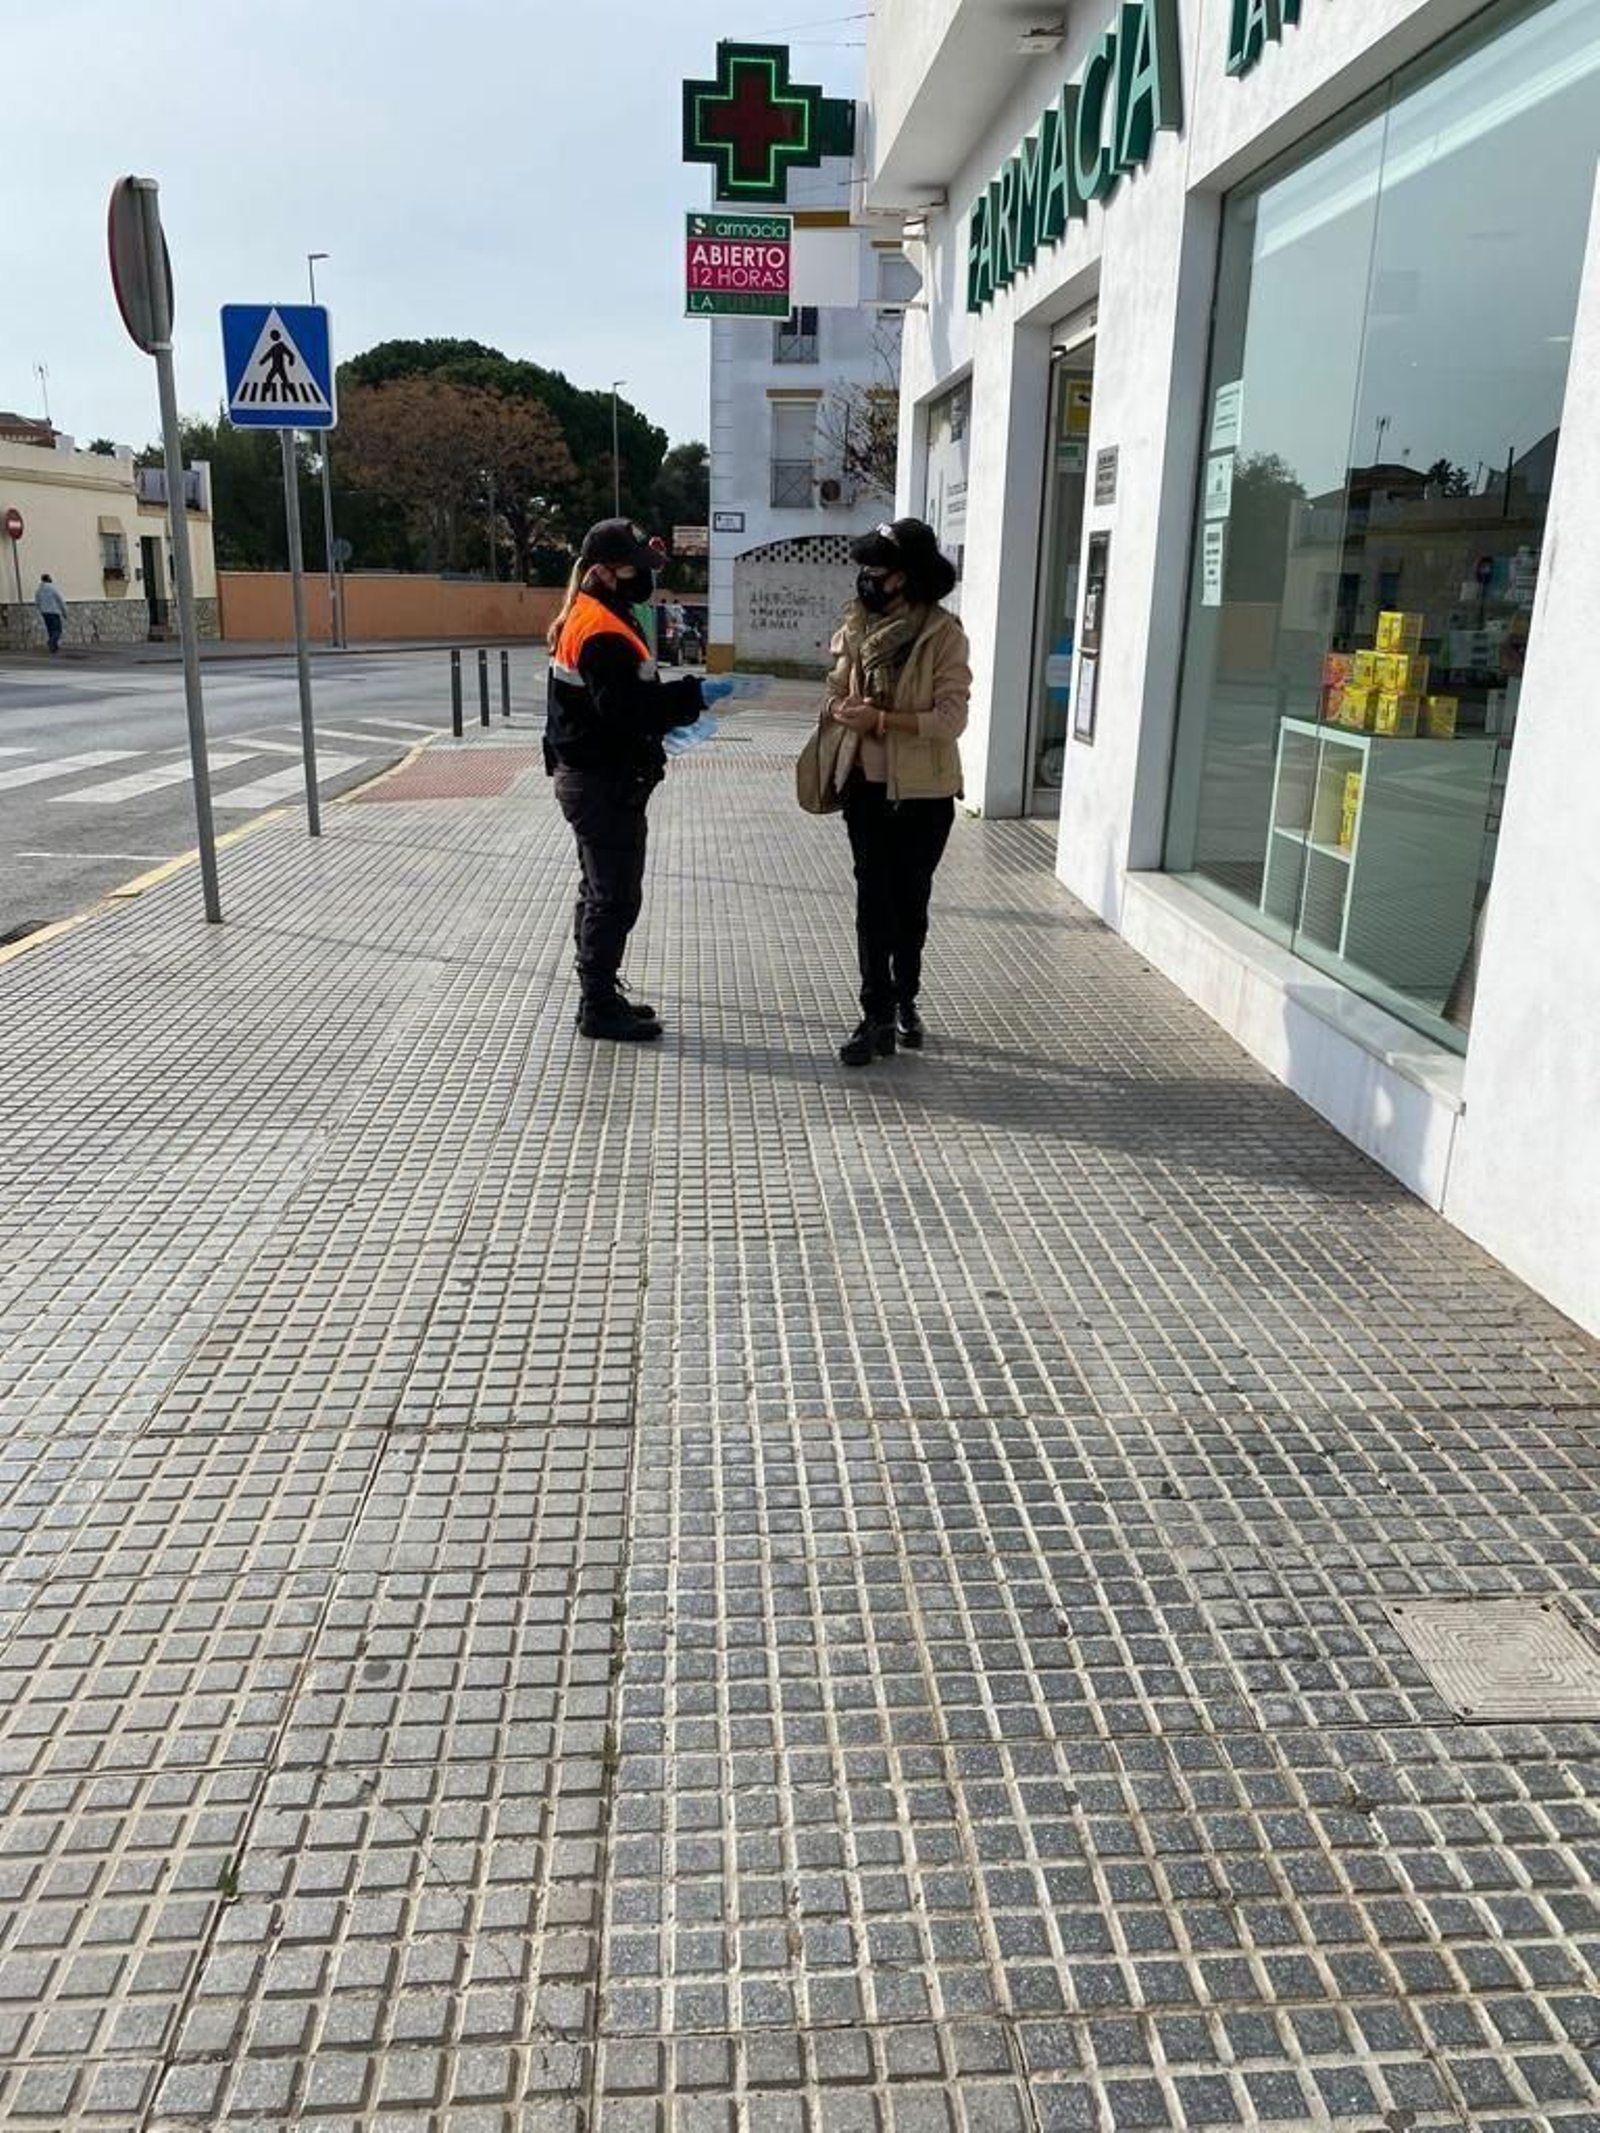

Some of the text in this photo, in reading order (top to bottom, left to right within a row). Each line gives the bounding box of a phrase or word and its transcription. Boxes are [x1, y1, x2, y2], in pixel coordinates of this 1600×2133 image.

[967, 0, 1182, 312] FARMACIA
[692, 245, 785, 268] ABIERTO
[692, 266, 786, 288] 12 HORAS
[690, 294, 714, 310] LA
